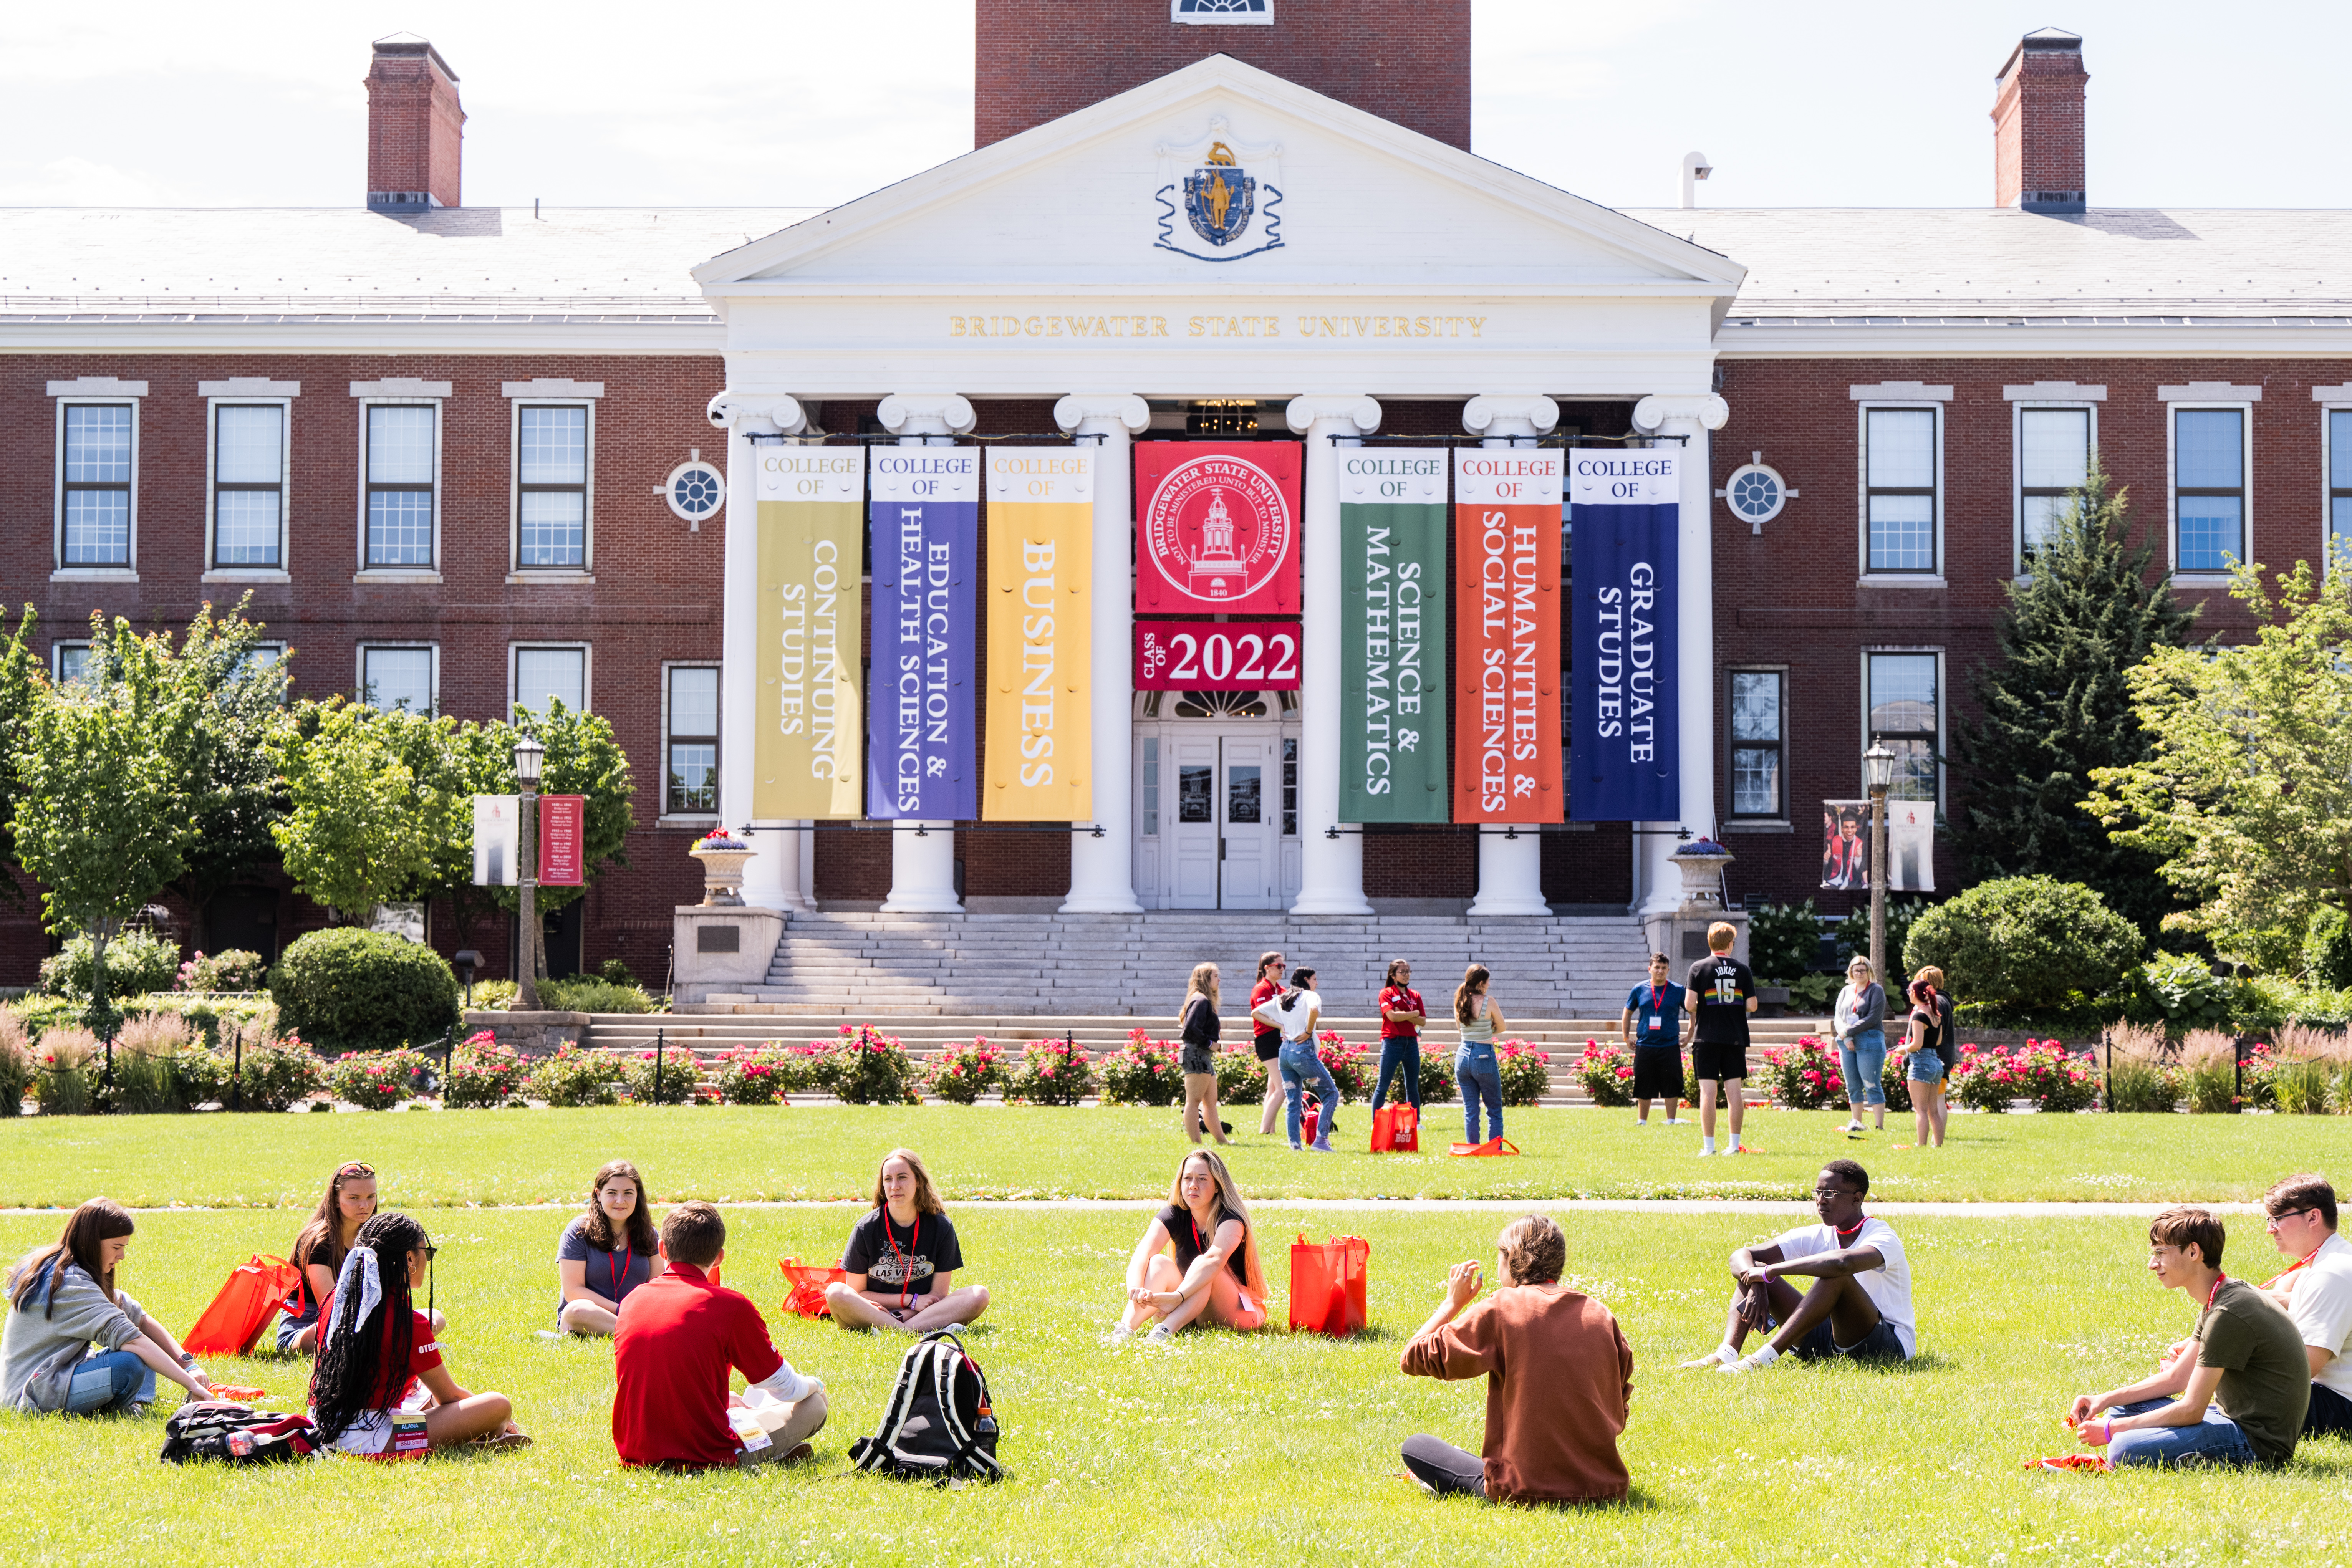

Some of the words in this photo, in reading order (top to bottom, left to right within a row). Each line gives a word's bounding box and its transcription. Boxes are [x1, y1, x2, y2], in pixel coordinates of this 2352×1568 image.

[950, 316, 1169, 337] BRIDGEWATER
[1188, 316, 1280, 337] STATE
[1297, 316, 1488, 337] UNIVERSITY
[764, 458, 857, 474] COLLEGE
[879, 458, 972, 474] COLLEGE
[994, 458, 1087, 475] COLLEGE
[1347, 459, 1441, 475] COLLEGE
[1462, 460, 1556, 476] COLLEGE
[1578, 460, 1672, 476] COLLEGE
[797, 479, 824, 495] OF
[912, 480, 939, 496] OF
[1027, 480, 1055, 497] OF
[1219, 476, 1246, 490] UNTO
[1380, 482, 1407, 497] OF
[1496, 482, 1523, 498] OF
[1611, 482, 1639, 498] OF
[1169, 476, 1216, 514] MINISTERED
[1246, 487, 1263, 504] BUT
[1154, 467, 1202, 558] BRIDGEWATER
[1204, 463, 1248, 479] STATE
[1250, 474, 1282, 558] UNIVERSITY
[1258, 504, 1268, 519] TO
[1166, 515, 1175, 527] BE
[1166, 529, 1175, 544] TO
[1249, 521, 1270, 564] MINISTER
[1170, 545, 1187, 565] NOT
[900, 507, 922, 644] HEALTH
[1482, 511, 1506, 639] SOCIAL
[1210, 588, 1228, 597] 1840
[926, 541, 950, 744] EDUCATION
[1397, 561, 1421, 715] SCIENCE
[1512, 525, 1537, 761] HUMANITIES
[780, 583, 806, 735] STUDIES
[811, 540, 838, 780] CONTINUING
[1019, 538, 1056, 788] BUSINESS
[1143, 632, 1156, 679] CLASS
[1155, 645, 1166, 667] OF
[1169, 633, 1297, 681] 2022
[1366, 525, 1390, 795] MATHEMATICS
[1598, 587, 1622, 738] STUDIES
[1630, 562, 1654, 763] GRADUATE
[898, 654, 921, 812] SCIENCES
[1397, 727, 1419, 753] &
[1482, 648, 1506, 813] SCIENCES
[926, 755, 947, 778] &
[1513, 773, 1536, 798] &
[1714, 965, 1736, 977] JOKIĆ
[1714, 978, 1736, 1003] 15
[1395, 1133, 1412, 1143] BSU
[2301, 1250, 2317, 1263] Bridgewater
[2267, 1273, 2282, 1285] University
[2210, 1281, 2220, 1300] Bridgewater
